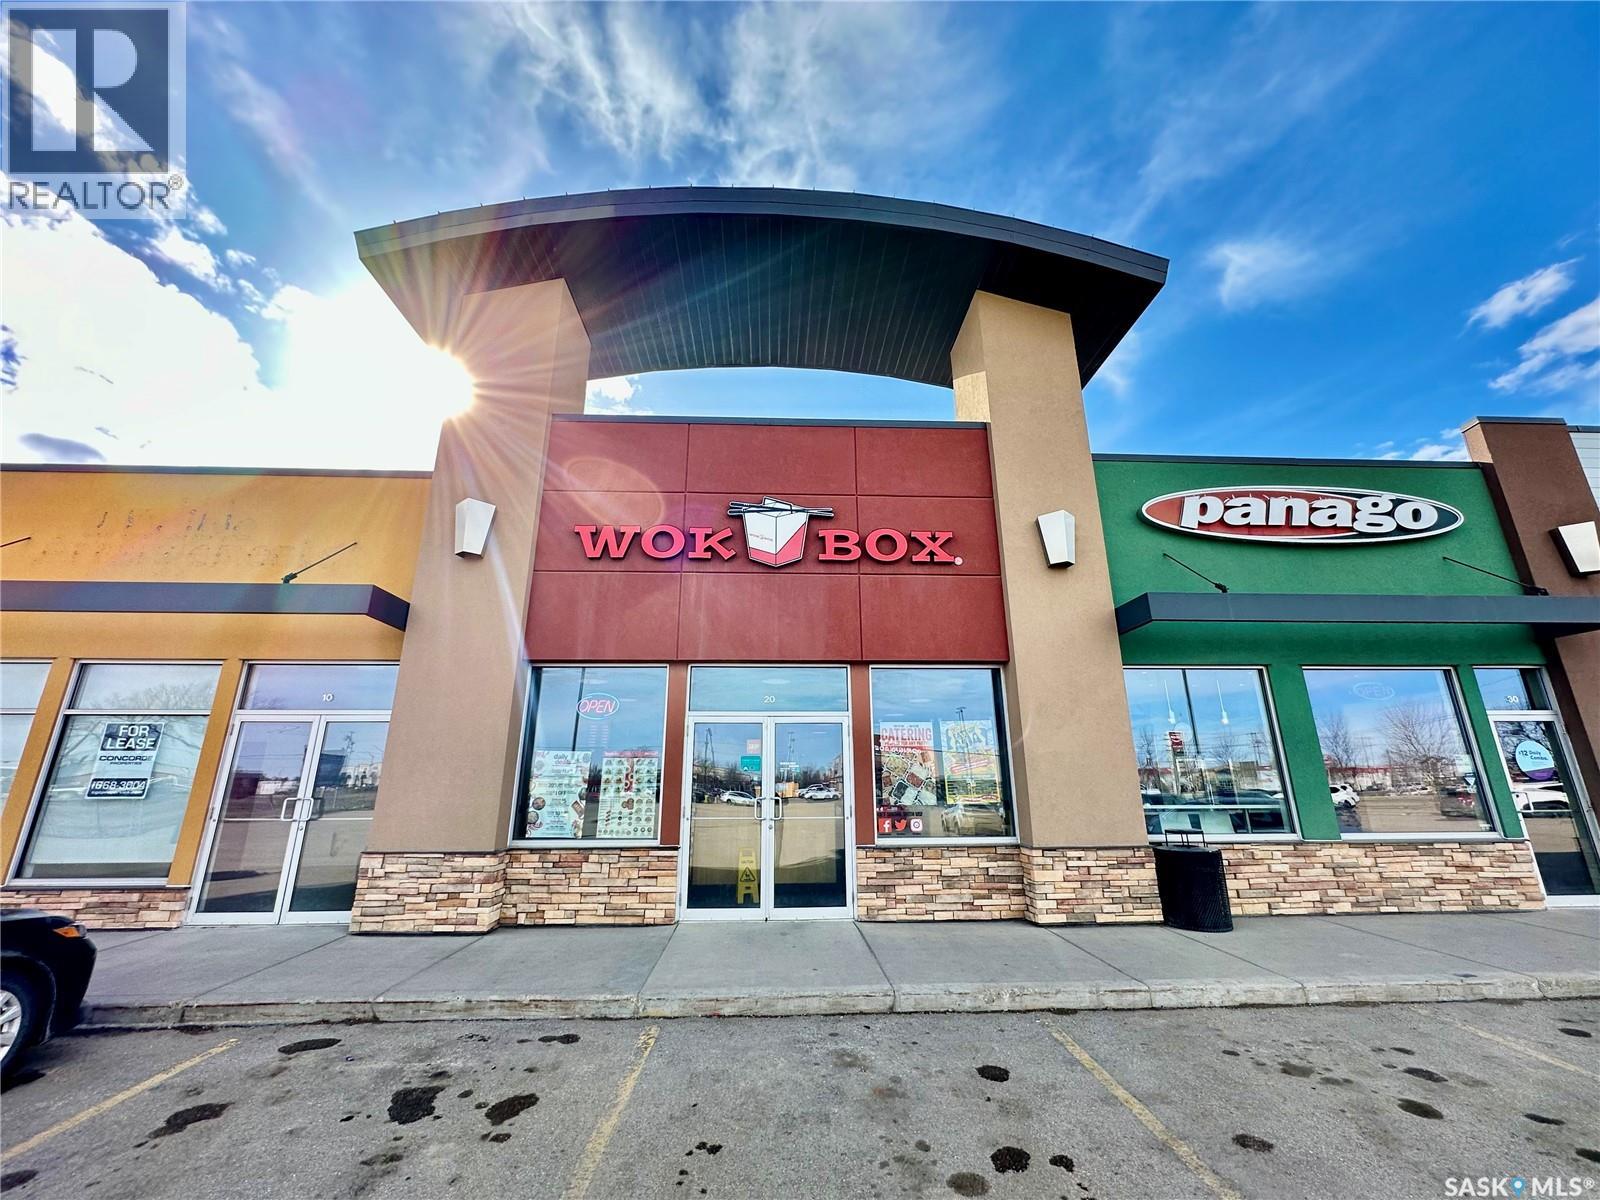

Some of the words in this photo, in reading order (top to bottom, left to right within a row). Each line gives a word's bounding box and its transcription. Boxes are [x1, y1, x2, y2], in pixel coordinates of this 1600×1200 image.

[1180, 493, 1438, 534] panago
[574, 524, 737, 561] WOK
[322, 693, 333, 702] 10
[763, 695, 776, 703] 20
[1507, 695, 1519, 703] 30
[579, 699, 616, 713] OPEN
[118, 725, 150, 737] FOR
[880, 727, 932, 741] CATERING
[106, 737, 156, 749] LEASE
